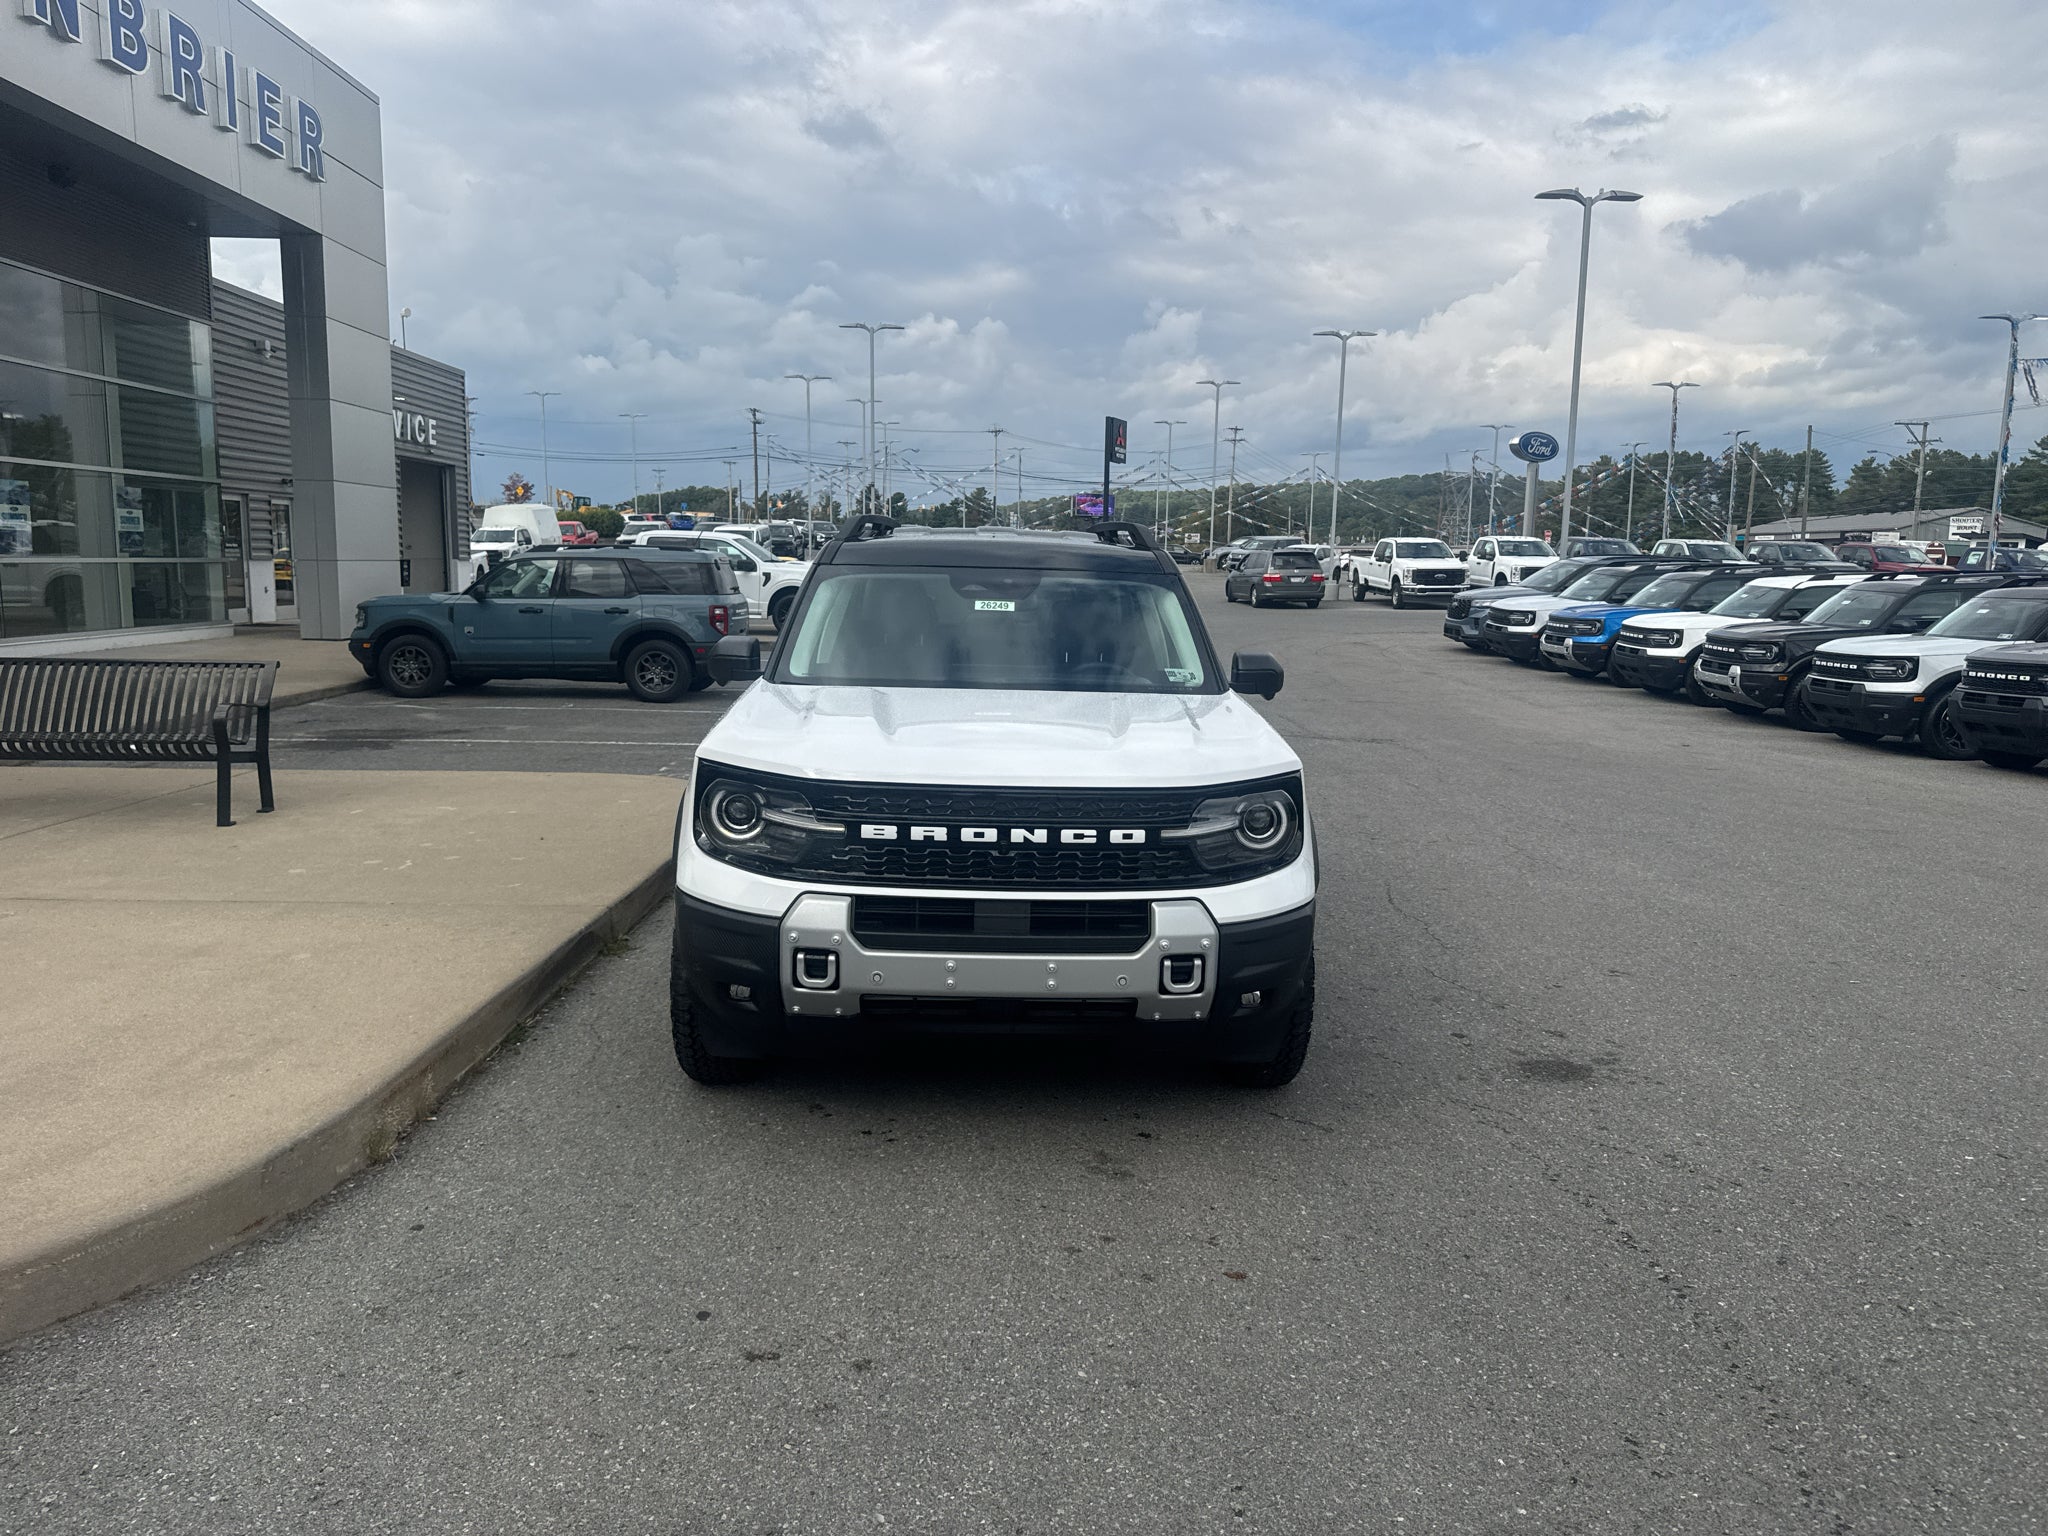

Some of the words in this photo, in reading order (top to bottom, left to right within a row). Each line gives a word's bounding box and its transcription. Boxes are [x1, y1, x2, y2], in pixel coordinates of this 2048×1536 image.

[392, 409, 437, 446] VICE
[1527, 436, 1553, 456] Ford
[980, 601, 1009, 610] 26249
[1704, 644, 1735, 652] BRONCO
[1815, 660, 1857, 669] BRONCO
[1968, 671, 2031, 681] BRONCO
[860, 824, 1147, 844] BRONCO
